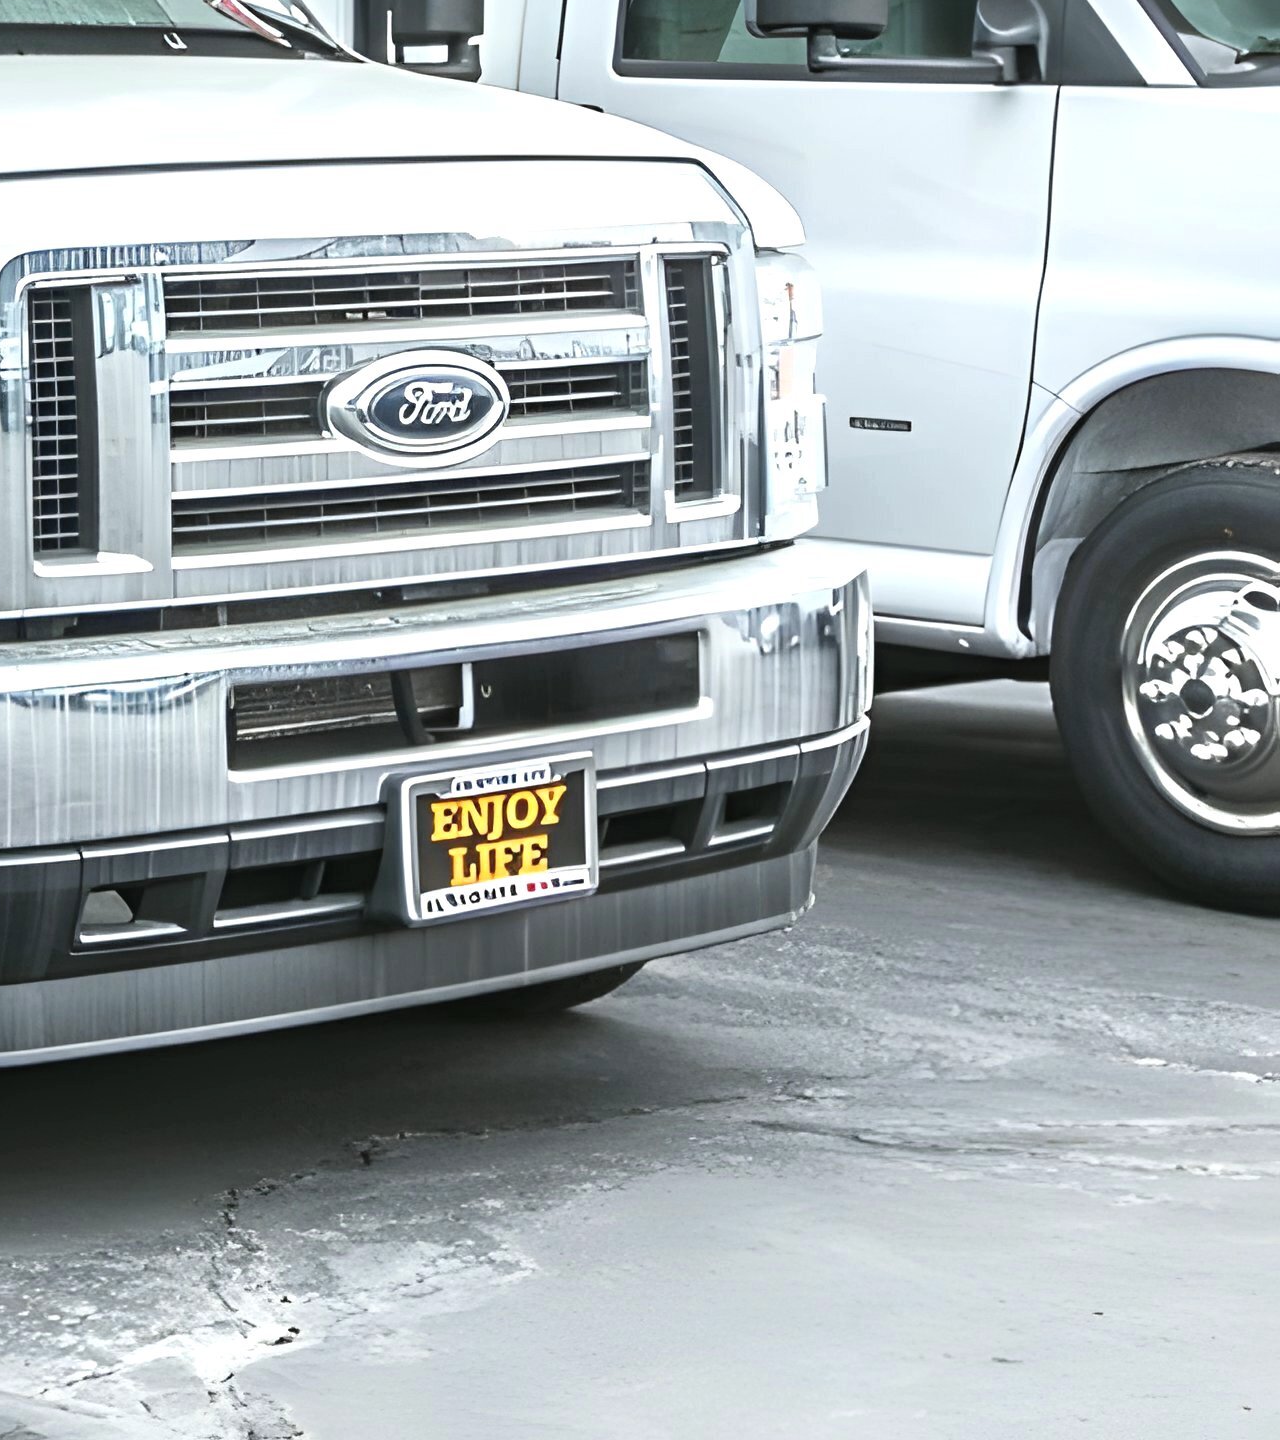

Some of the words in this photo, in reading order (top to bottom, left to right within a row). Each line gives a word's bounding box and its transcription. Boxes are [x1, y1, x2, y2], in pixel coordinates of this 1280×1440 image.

[398, 381, 473, 425] Ford
[430, 784, 567, 842] ENJOY
[448, 833, 549, 888] LIFE
